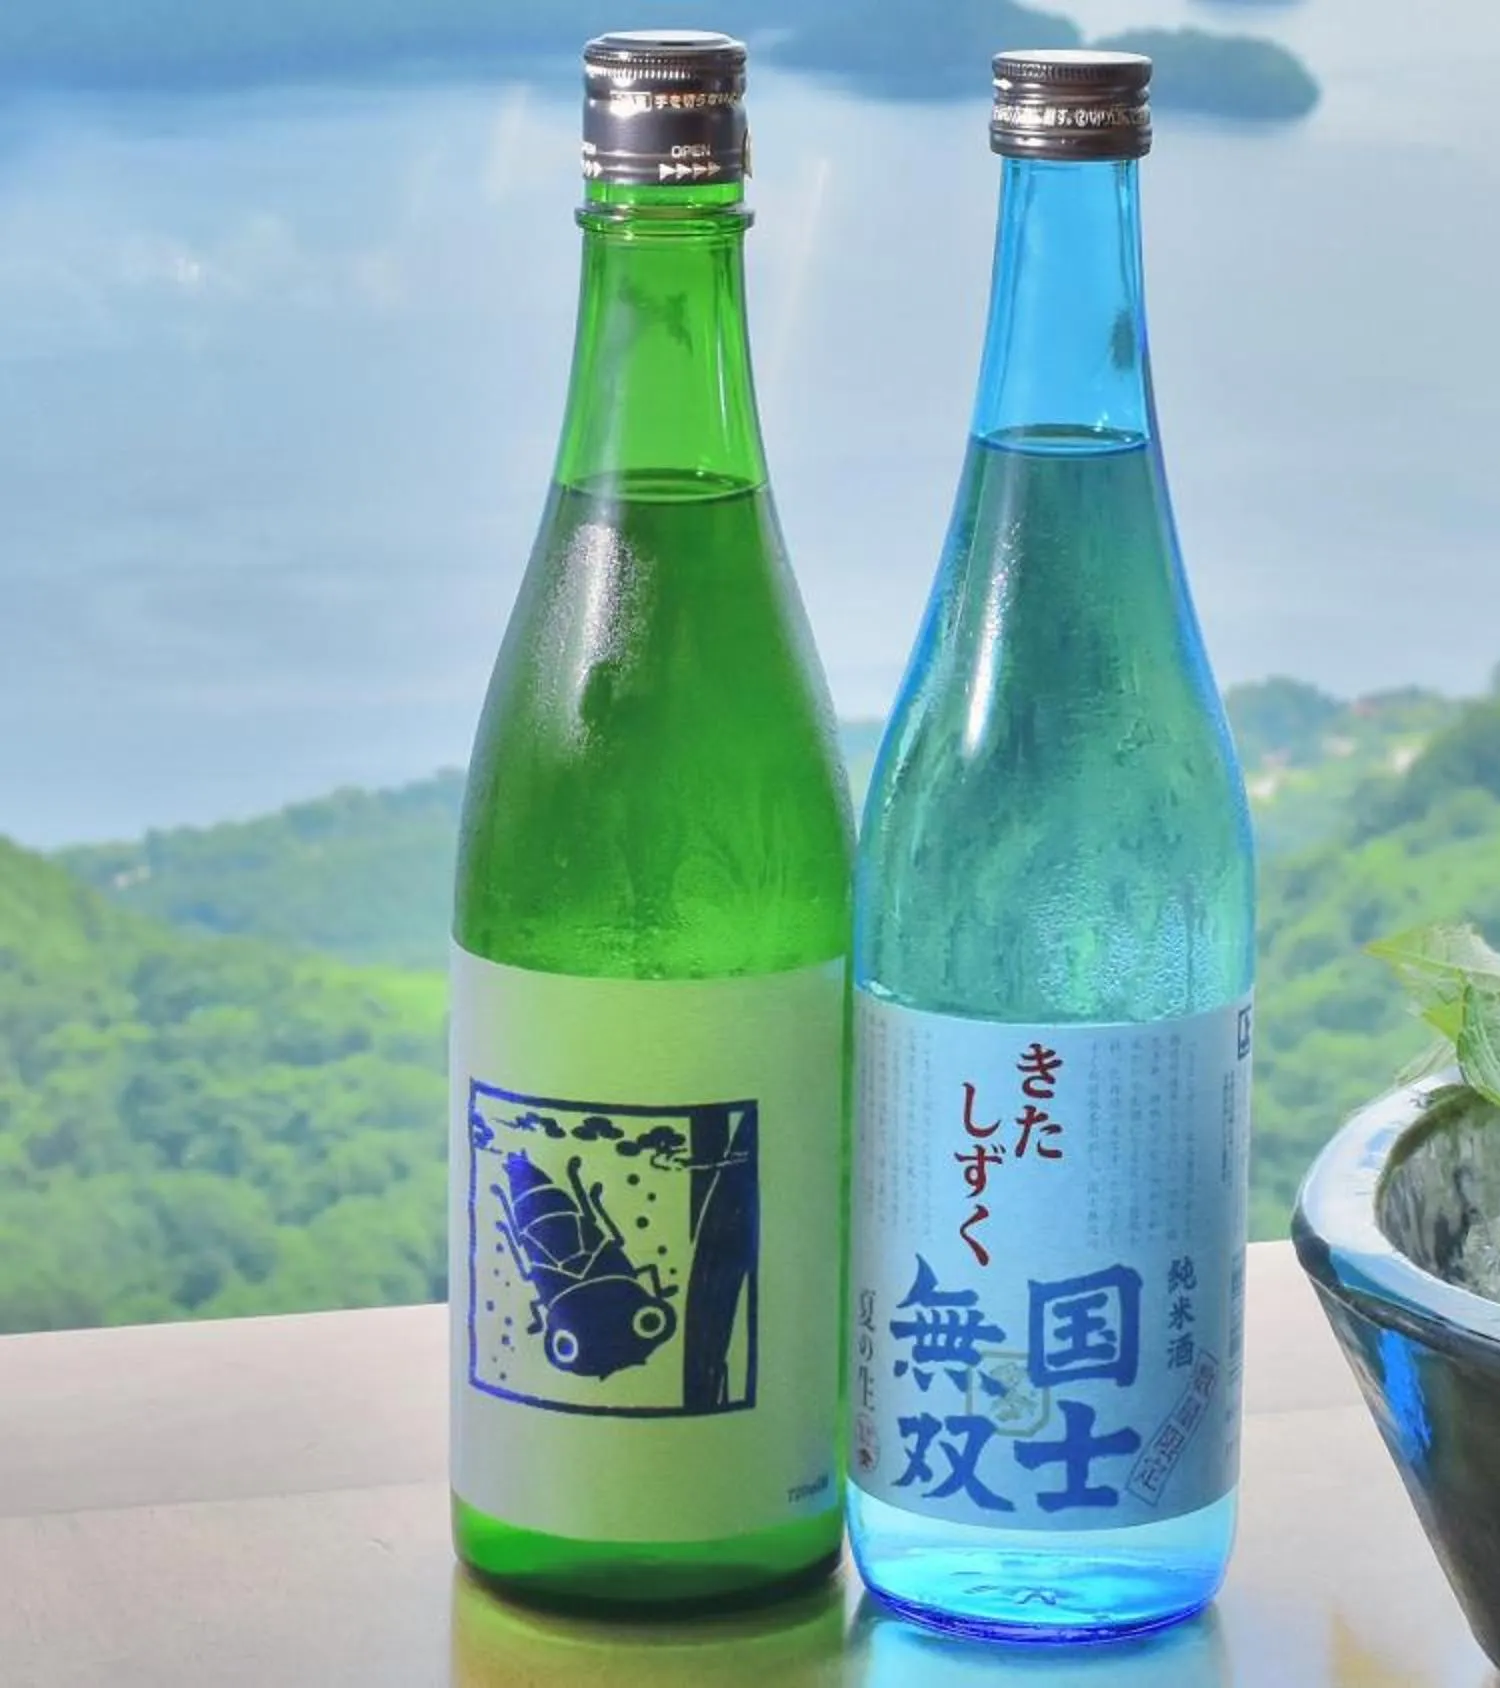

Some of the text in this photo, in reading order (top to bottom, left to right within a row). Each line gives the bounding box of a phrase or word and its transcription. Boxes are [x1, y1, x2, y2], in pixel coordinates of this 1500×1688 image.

[671, 144, 711, 158] OPEN
[1015, 1043, 1063, 1158] きた
[954, 1082, 1005, 1266] しずく
[1167, 1256, 1197, 1369] 純米酒
